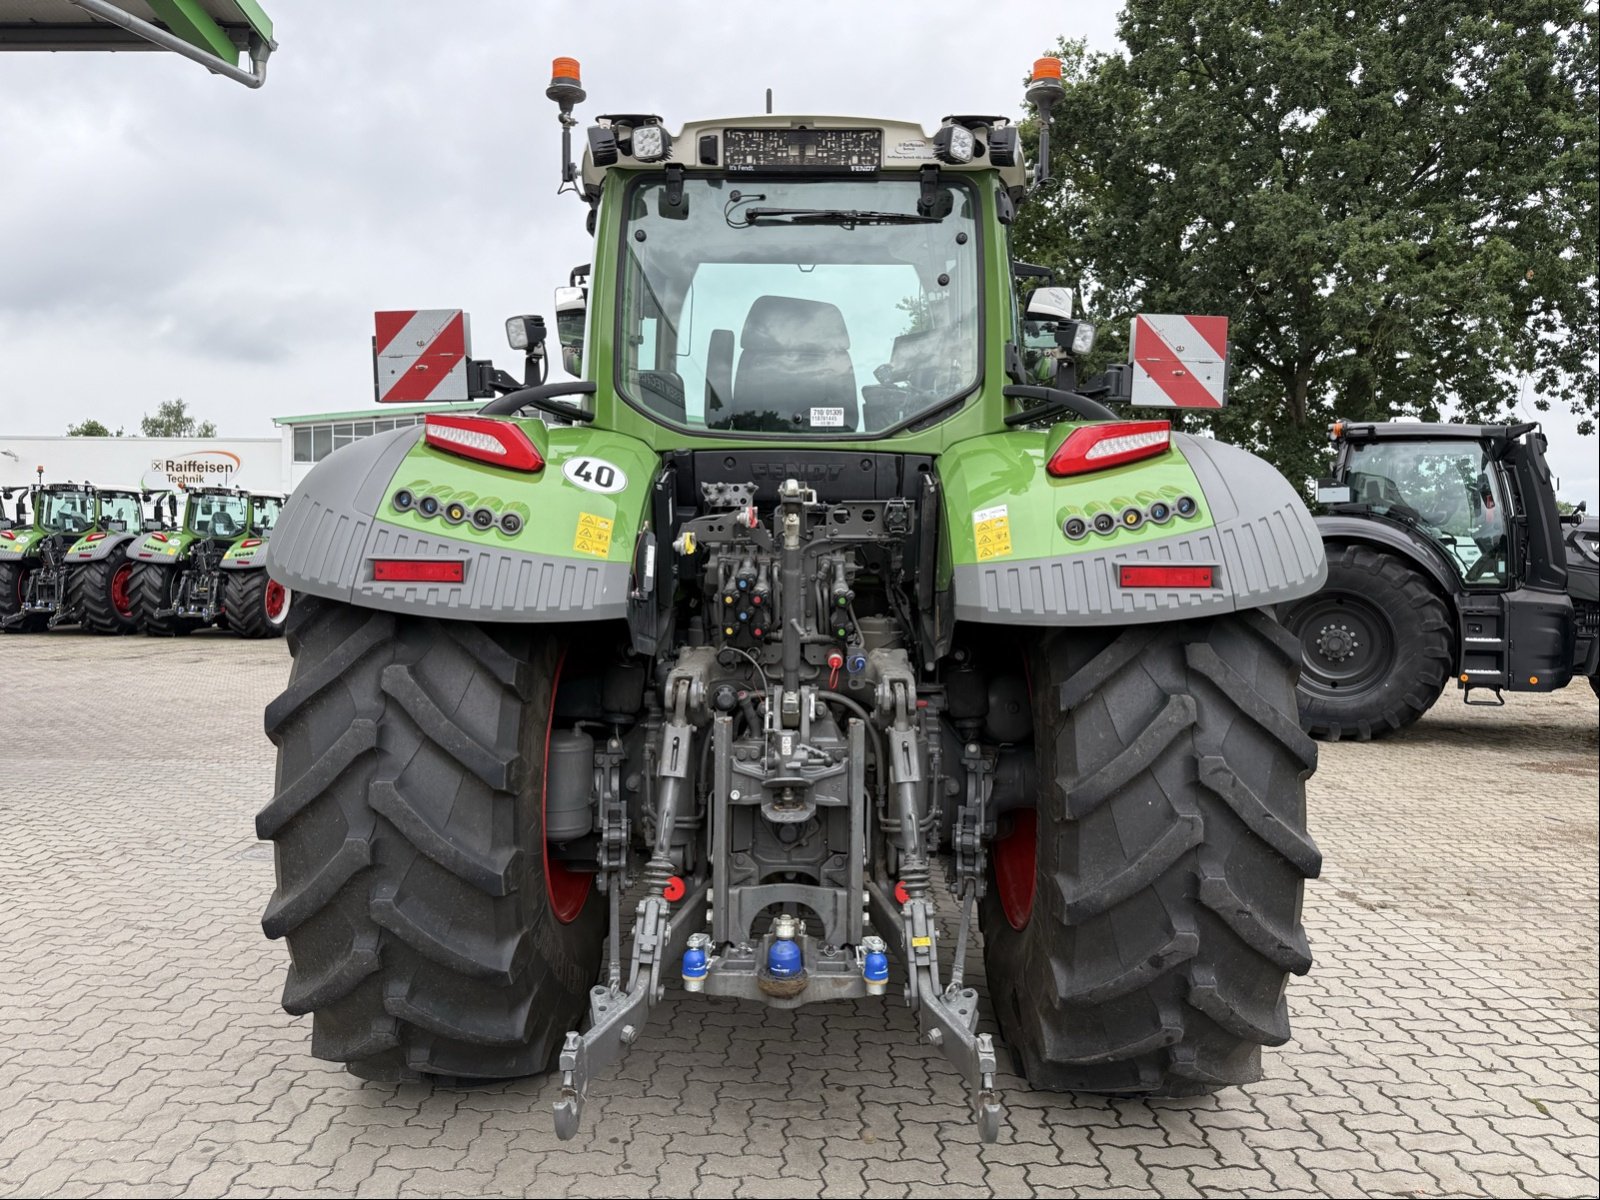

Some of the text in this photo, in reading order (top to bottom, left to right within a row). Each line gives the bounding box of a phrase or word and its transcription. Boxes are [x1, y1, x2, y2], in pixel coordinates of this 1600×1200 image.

[165, 460, 233, 473] Raiffeisen
[574, 460, 615, 488] 40
[751, 463, 846, 481] FENDT
[166, 474, 205, 483] Technik
